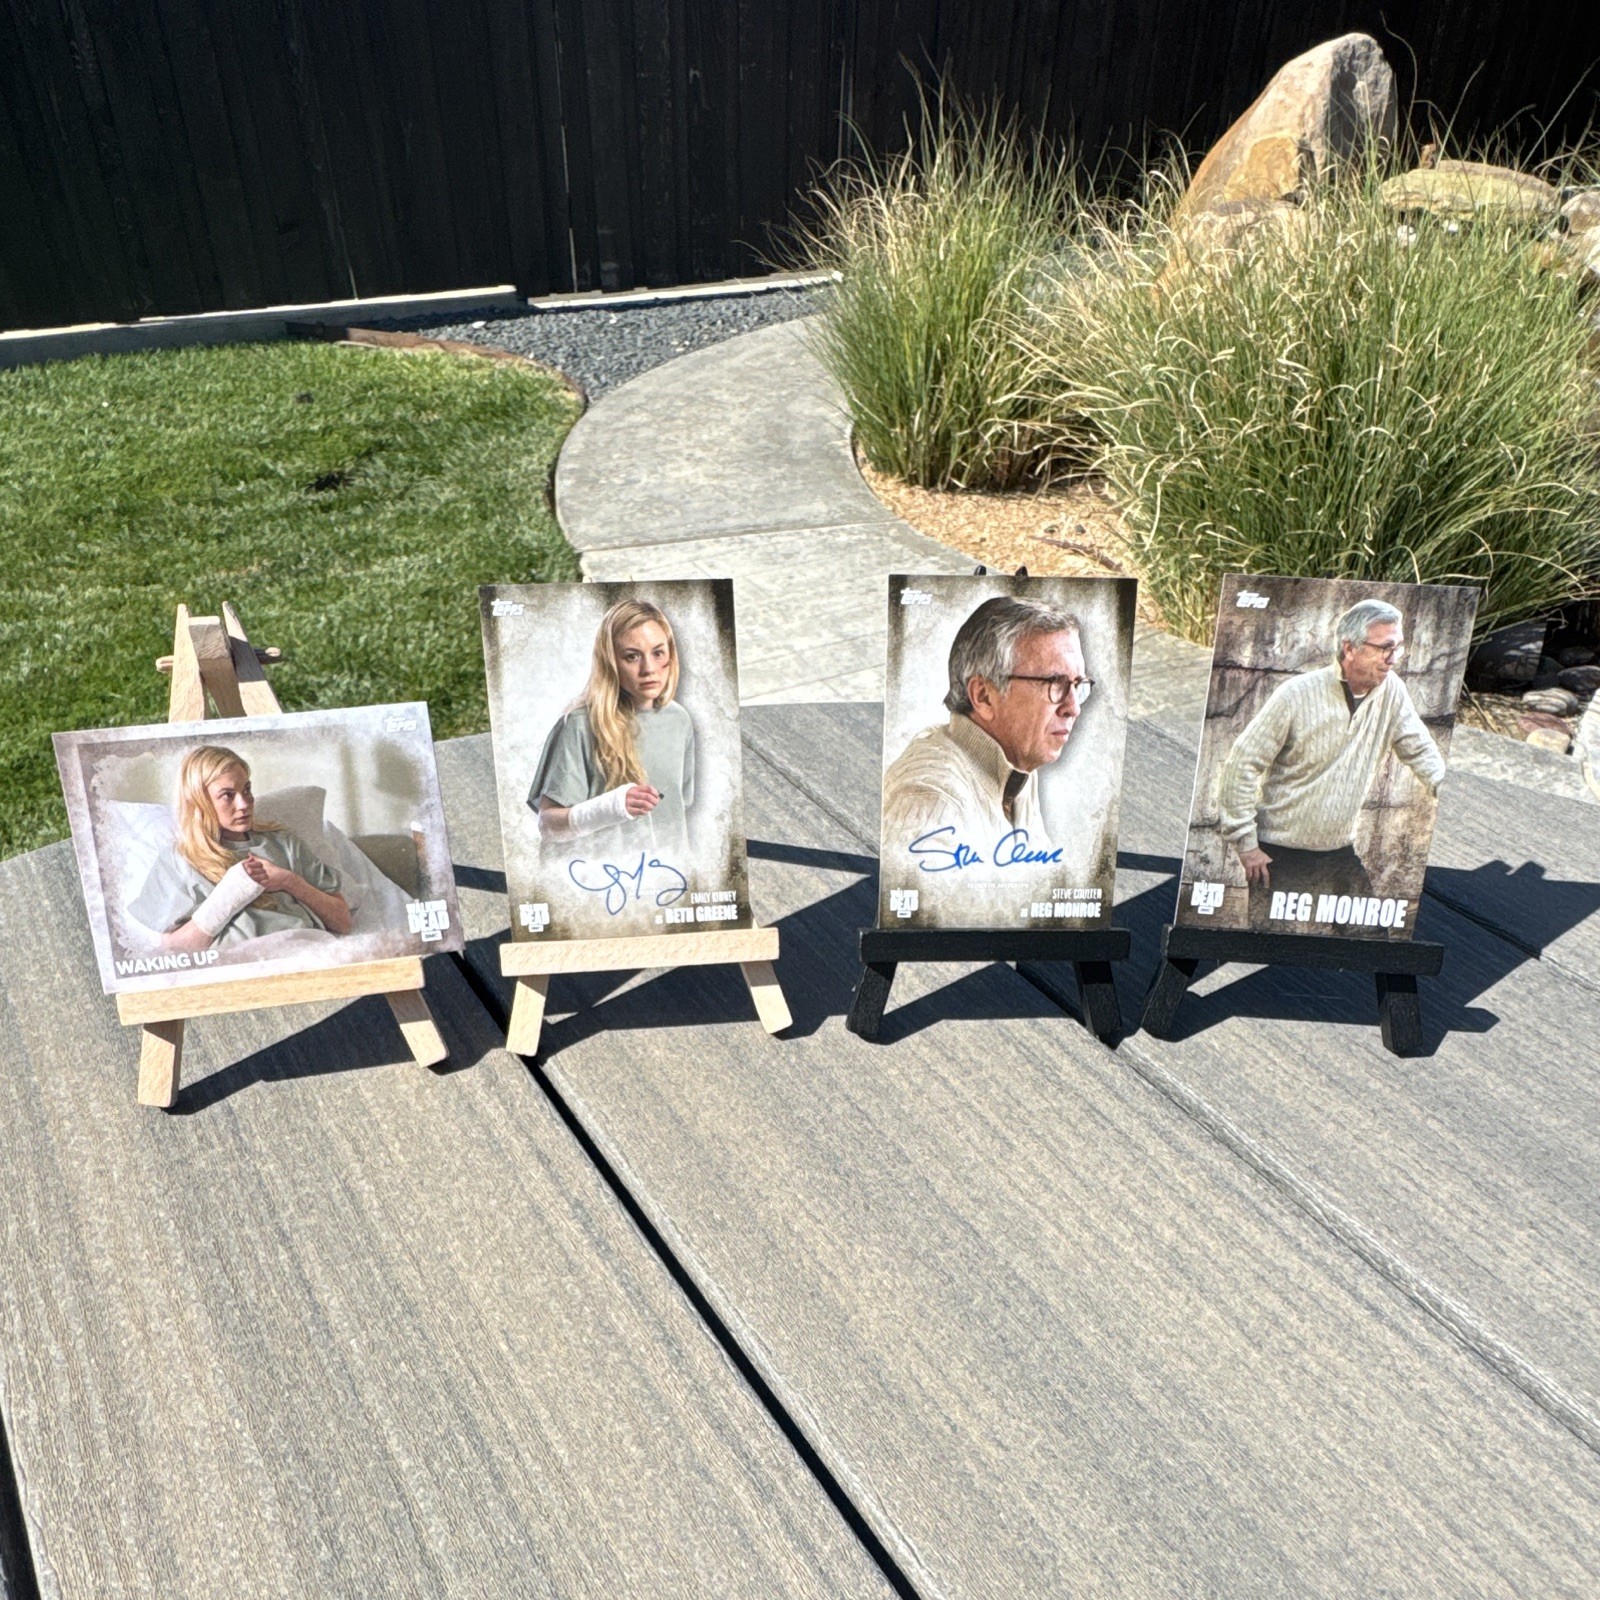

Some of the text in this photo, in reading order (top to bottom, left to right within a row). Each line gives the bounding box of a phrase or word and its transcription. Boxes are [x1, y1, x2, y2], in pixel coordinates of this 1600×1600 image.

[665, 907, 695, 924] BETH
[695, 904, 738, 922] GREENE
[1030, 902, 1053, 918] REG
[1053, 902, 1102, 918] MONROE
[1269, 891, 1409, 928] REG MONROE
[115, 949, 219, 975] WAKING UP
